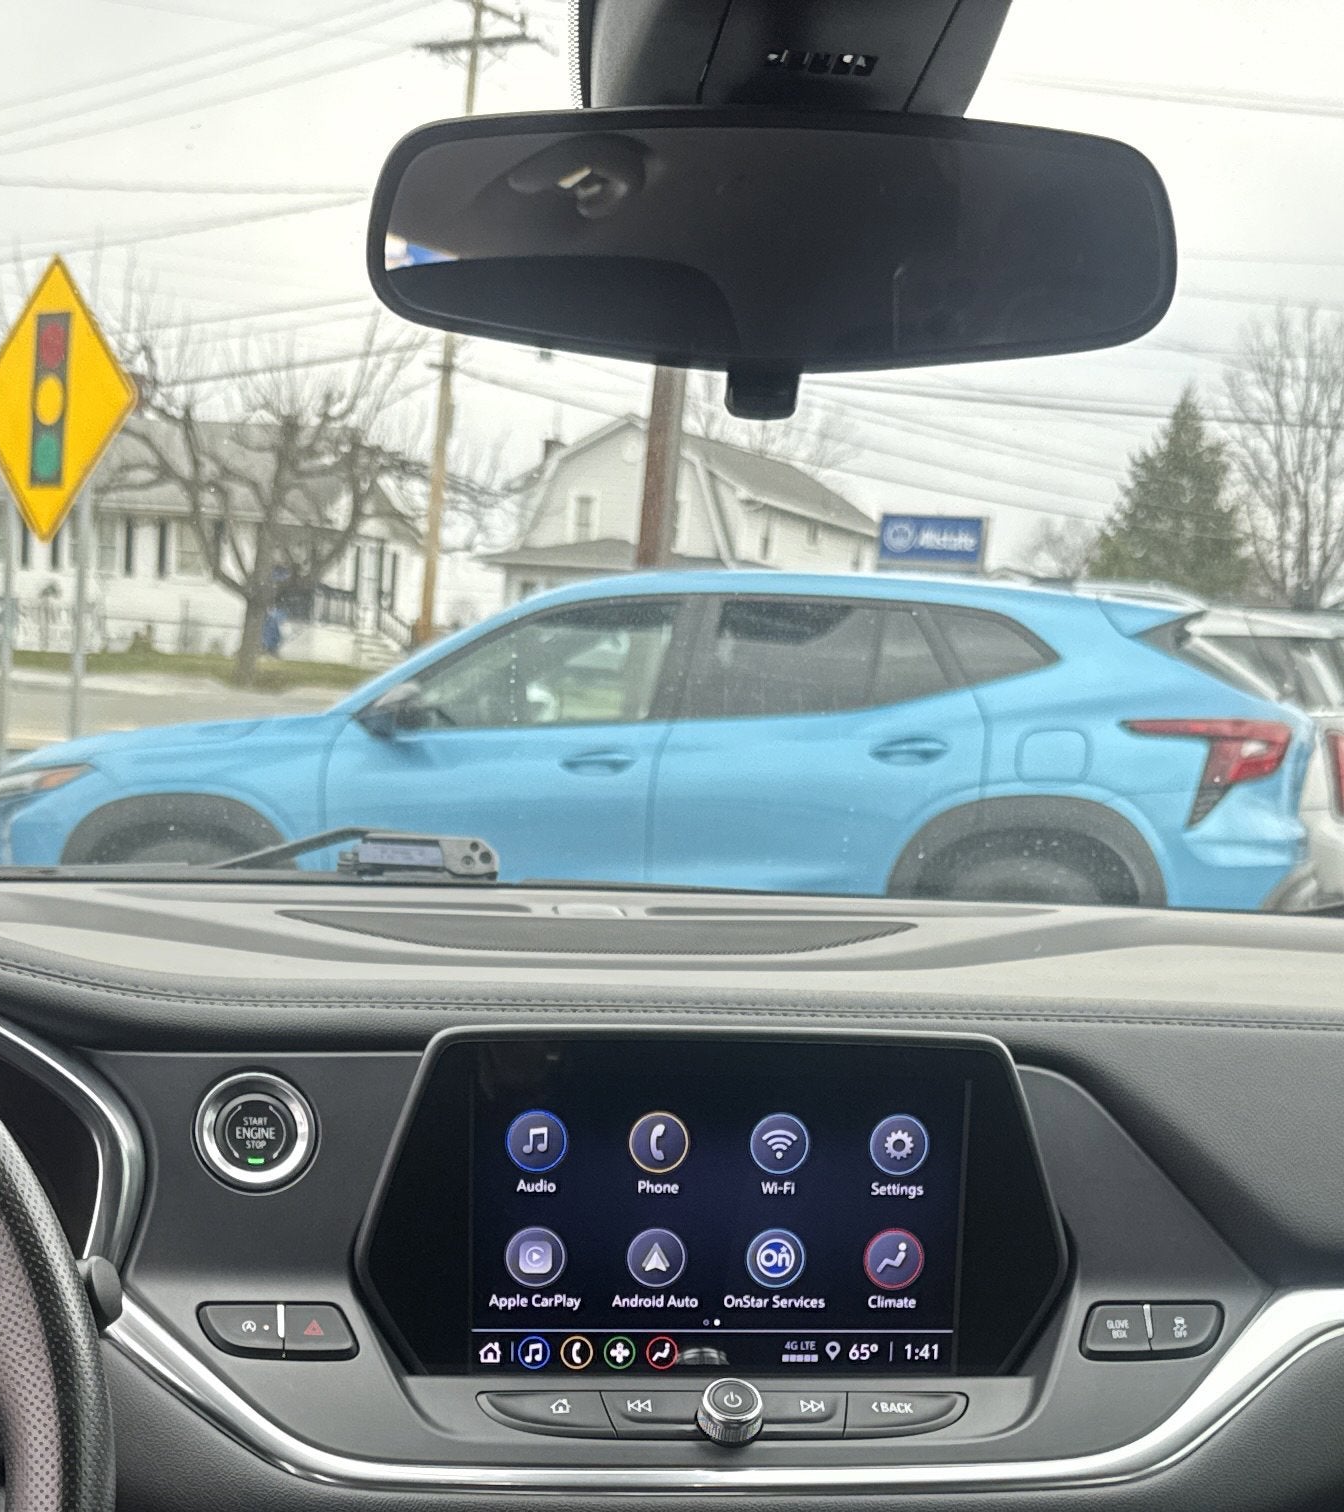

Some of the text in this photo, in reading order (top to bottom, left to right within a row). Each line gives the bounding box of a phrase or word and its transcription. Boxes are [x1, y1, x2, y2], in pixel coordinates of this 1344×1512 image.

[243, 1116, 267, 1125] START
[235, 1126, 276, 1140] ENGINE
[245, 1139, 266, 1149] STOP
[516, 1179, 557, 1194] Audio
[637, 1180, 679, 1195] Phone
[760, 1181, 795, 1196] Wi-Fi
[870, 1181, 924, 1199] Settings
[488, 1293, 582, 1311] Apple CarPlay
[611, 1294, 699, 1308] Android Auto
[723, 1294, 826, 1309] OnStar Services
[867, 1295, 917, 1309] Climate
[784, 1341, 816, 1351] 4G LTE
[904, 1343, 940, 1361] 1:41
[880, 1400, 914, 1414] BACK
